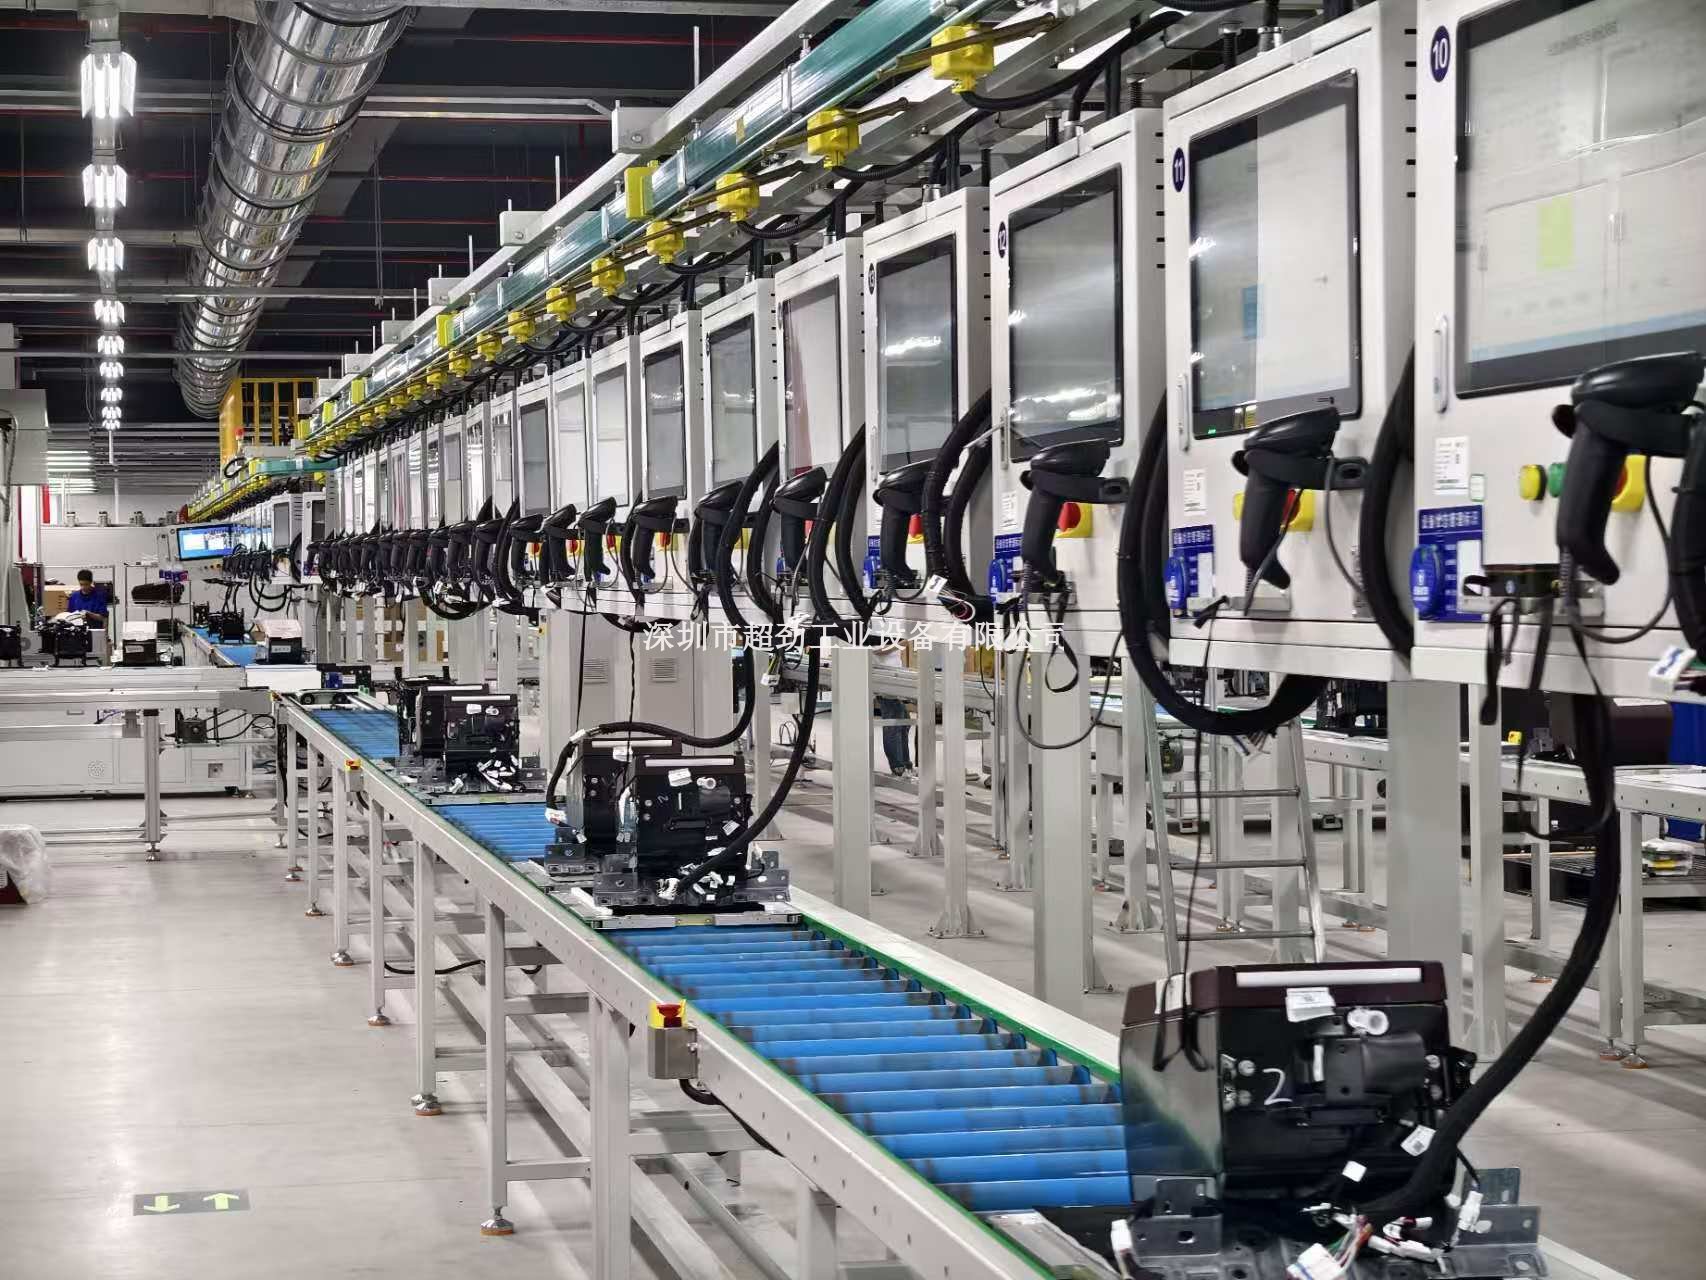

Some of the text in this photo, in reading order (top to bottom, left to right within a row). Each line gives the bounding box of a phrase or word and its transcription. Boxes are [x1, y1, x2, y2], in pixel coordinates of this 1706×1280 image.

[1433, 37, 1448, 70] 10
[1174, 157, 1184, 183] 11
[1263, 1068, 1293, 1105] 2
